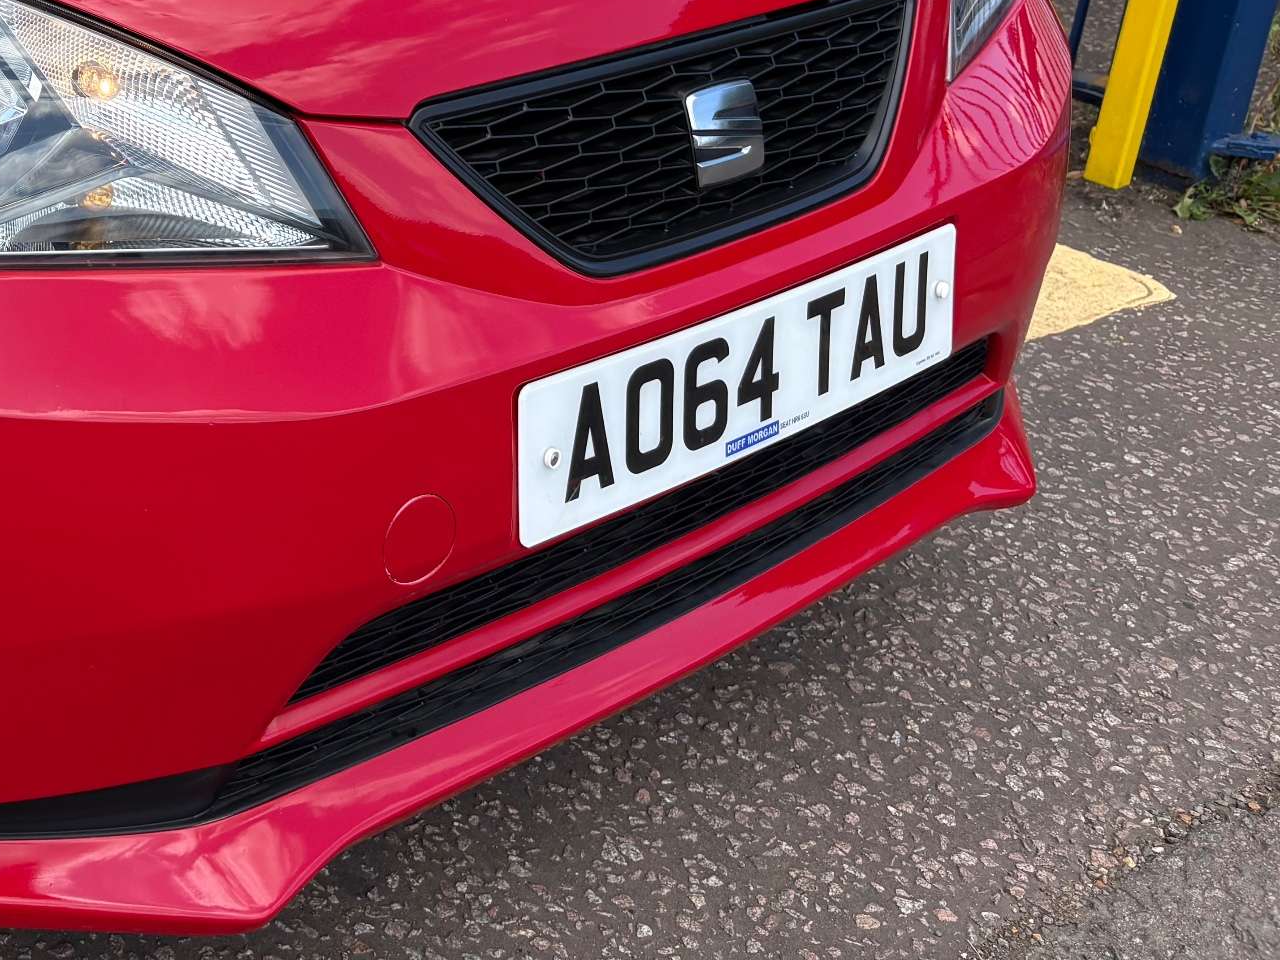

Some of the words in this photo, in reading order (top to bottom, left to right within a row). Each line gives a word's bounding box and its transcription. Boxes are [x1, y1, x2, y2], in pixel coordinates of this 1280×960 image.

[806, 250, 929, 397] TAU
[727, 439, 746, 454] DUFF
[747, 423, 778, 445] MORGAN
